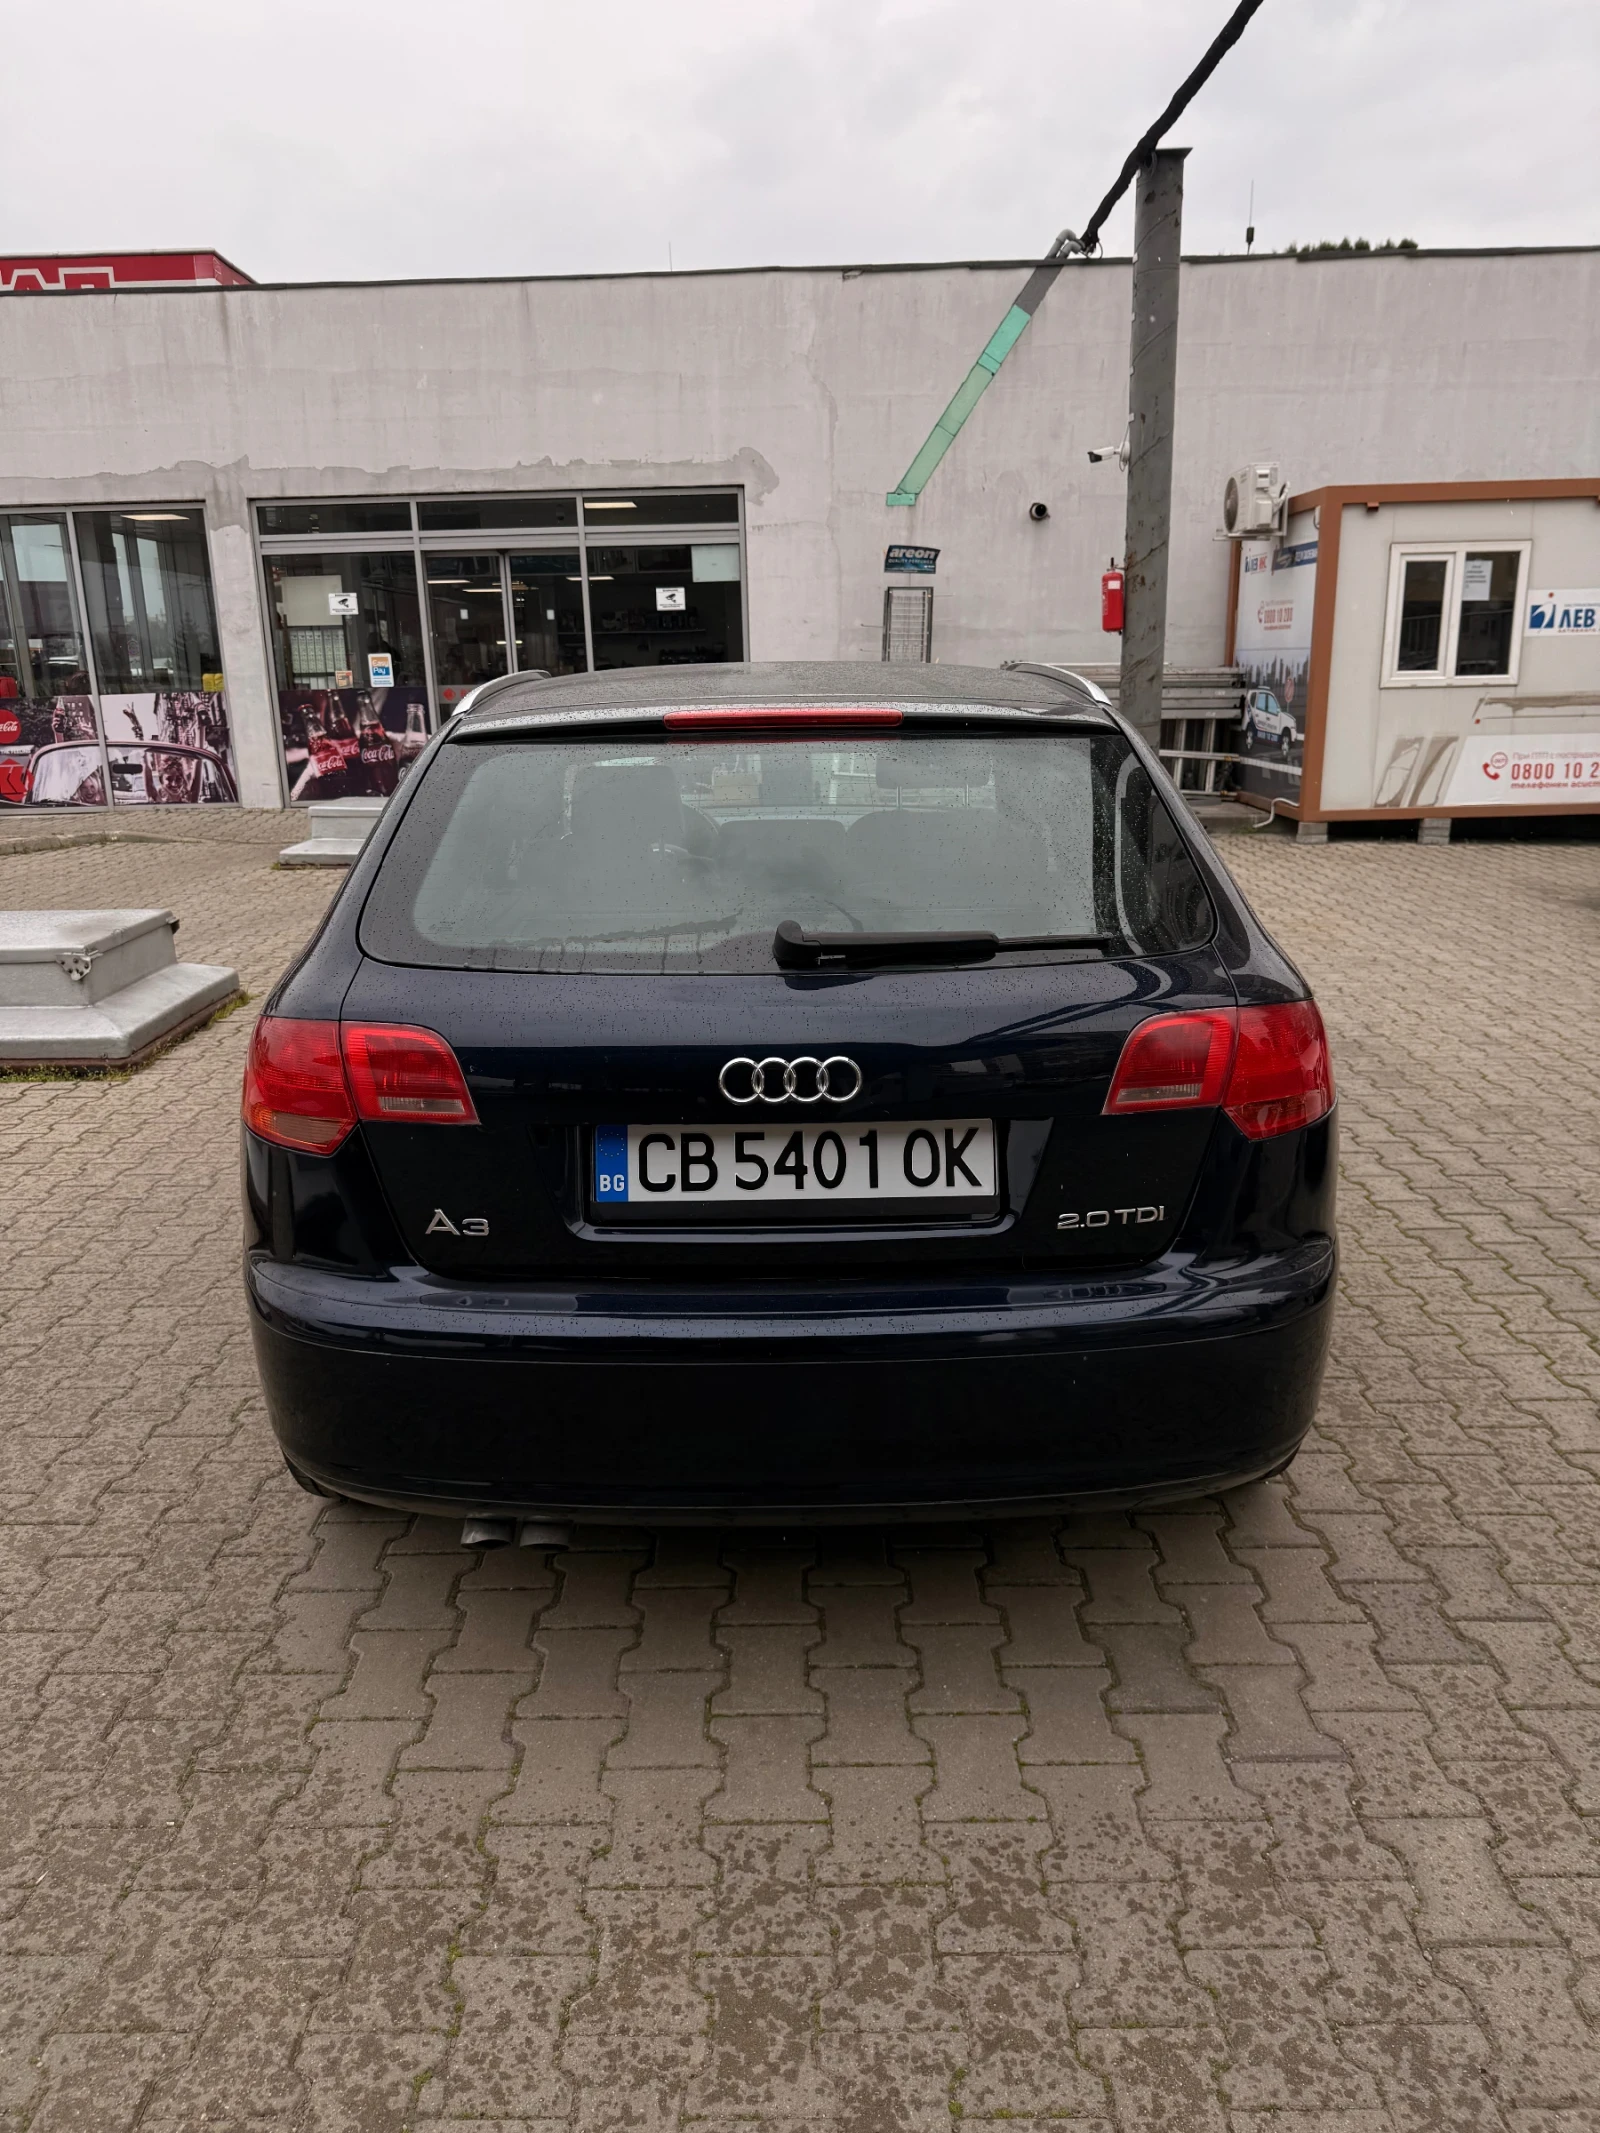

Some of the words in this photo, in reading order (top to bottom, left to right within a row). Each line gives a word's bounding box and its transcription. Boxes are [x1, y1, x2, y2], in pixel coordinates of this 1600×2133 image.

[889, 548, 936, 559] areon
[1558, 608, 1596, 629] ЛЕВ
[373, 667, 386, 675] Pay
[1511, 763, 1554, 780] 0800
[1565, 762, 1582, 779] 10
[638, 1132, 718, 1193] CB
[734, 1129, 878, 1191] 5401
[903, 1126, 982, 1188] OK
[600, 1174, 625, 1192] BG
[425, 1208, 489, 1236] A3
[1057, 1210, 1110, 1230] 2.0
[1114, 1205, 1165, 1224] TDI
